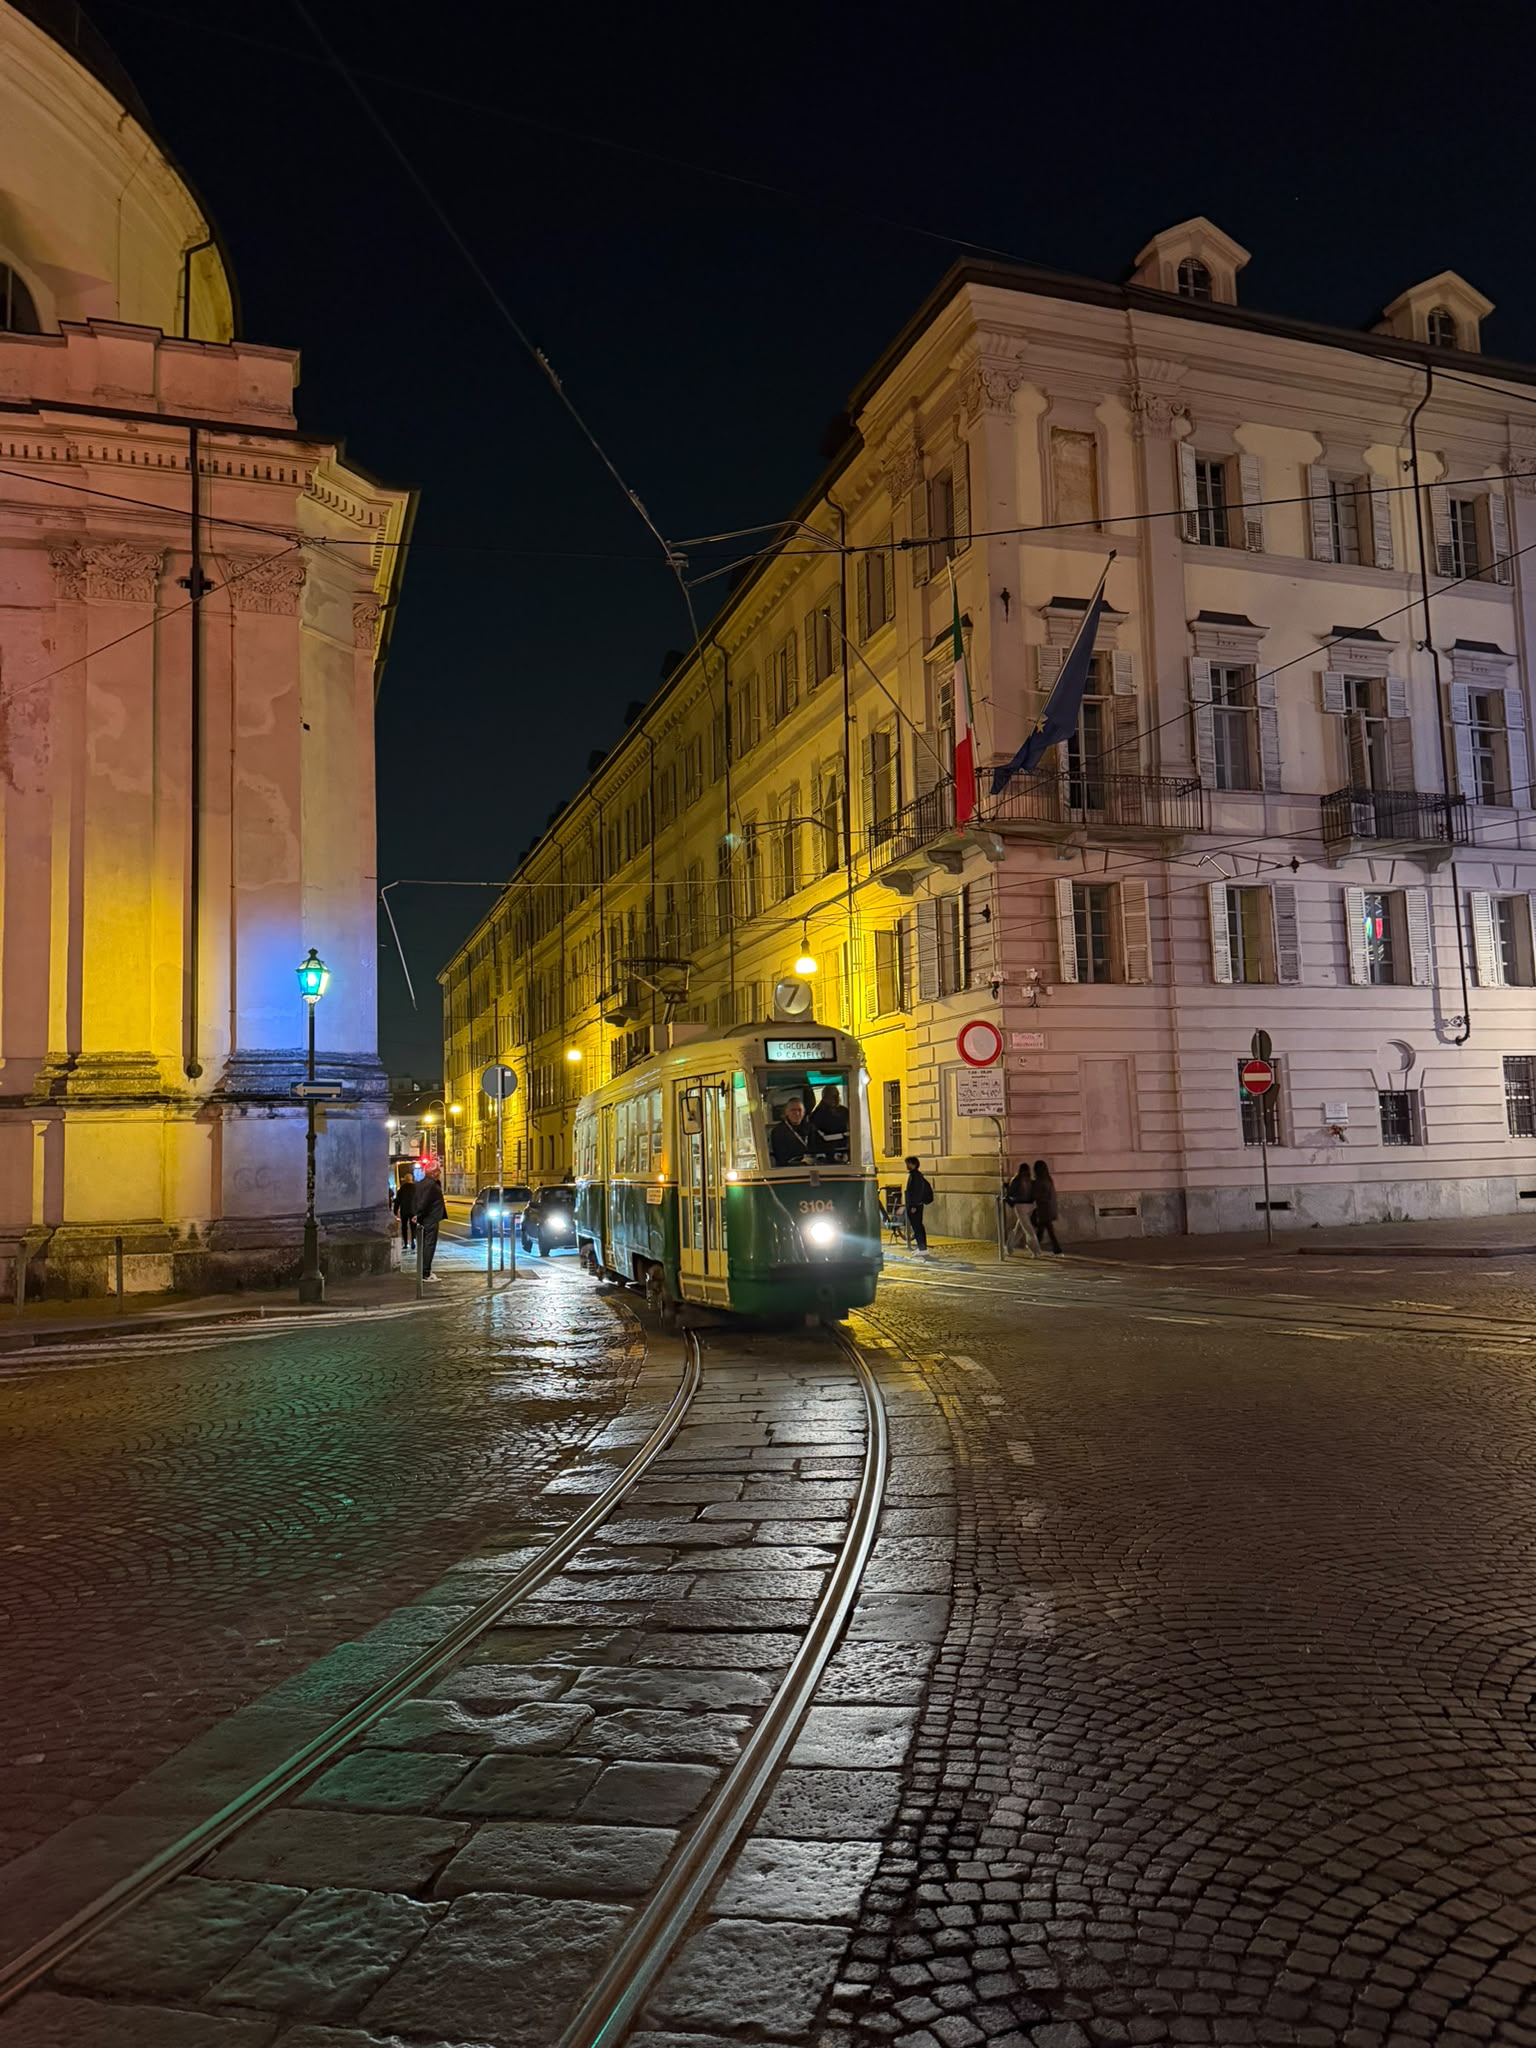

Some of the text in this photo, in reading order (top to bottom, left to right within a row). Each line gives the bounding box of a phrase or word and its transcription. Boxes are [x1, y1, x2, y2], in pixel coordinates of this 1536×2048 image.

[784, 984, 800, 1008] 7
[778, 1042, 822, 1050] CIRCOLARE
[799, 1200, 833, 1214] 3104
